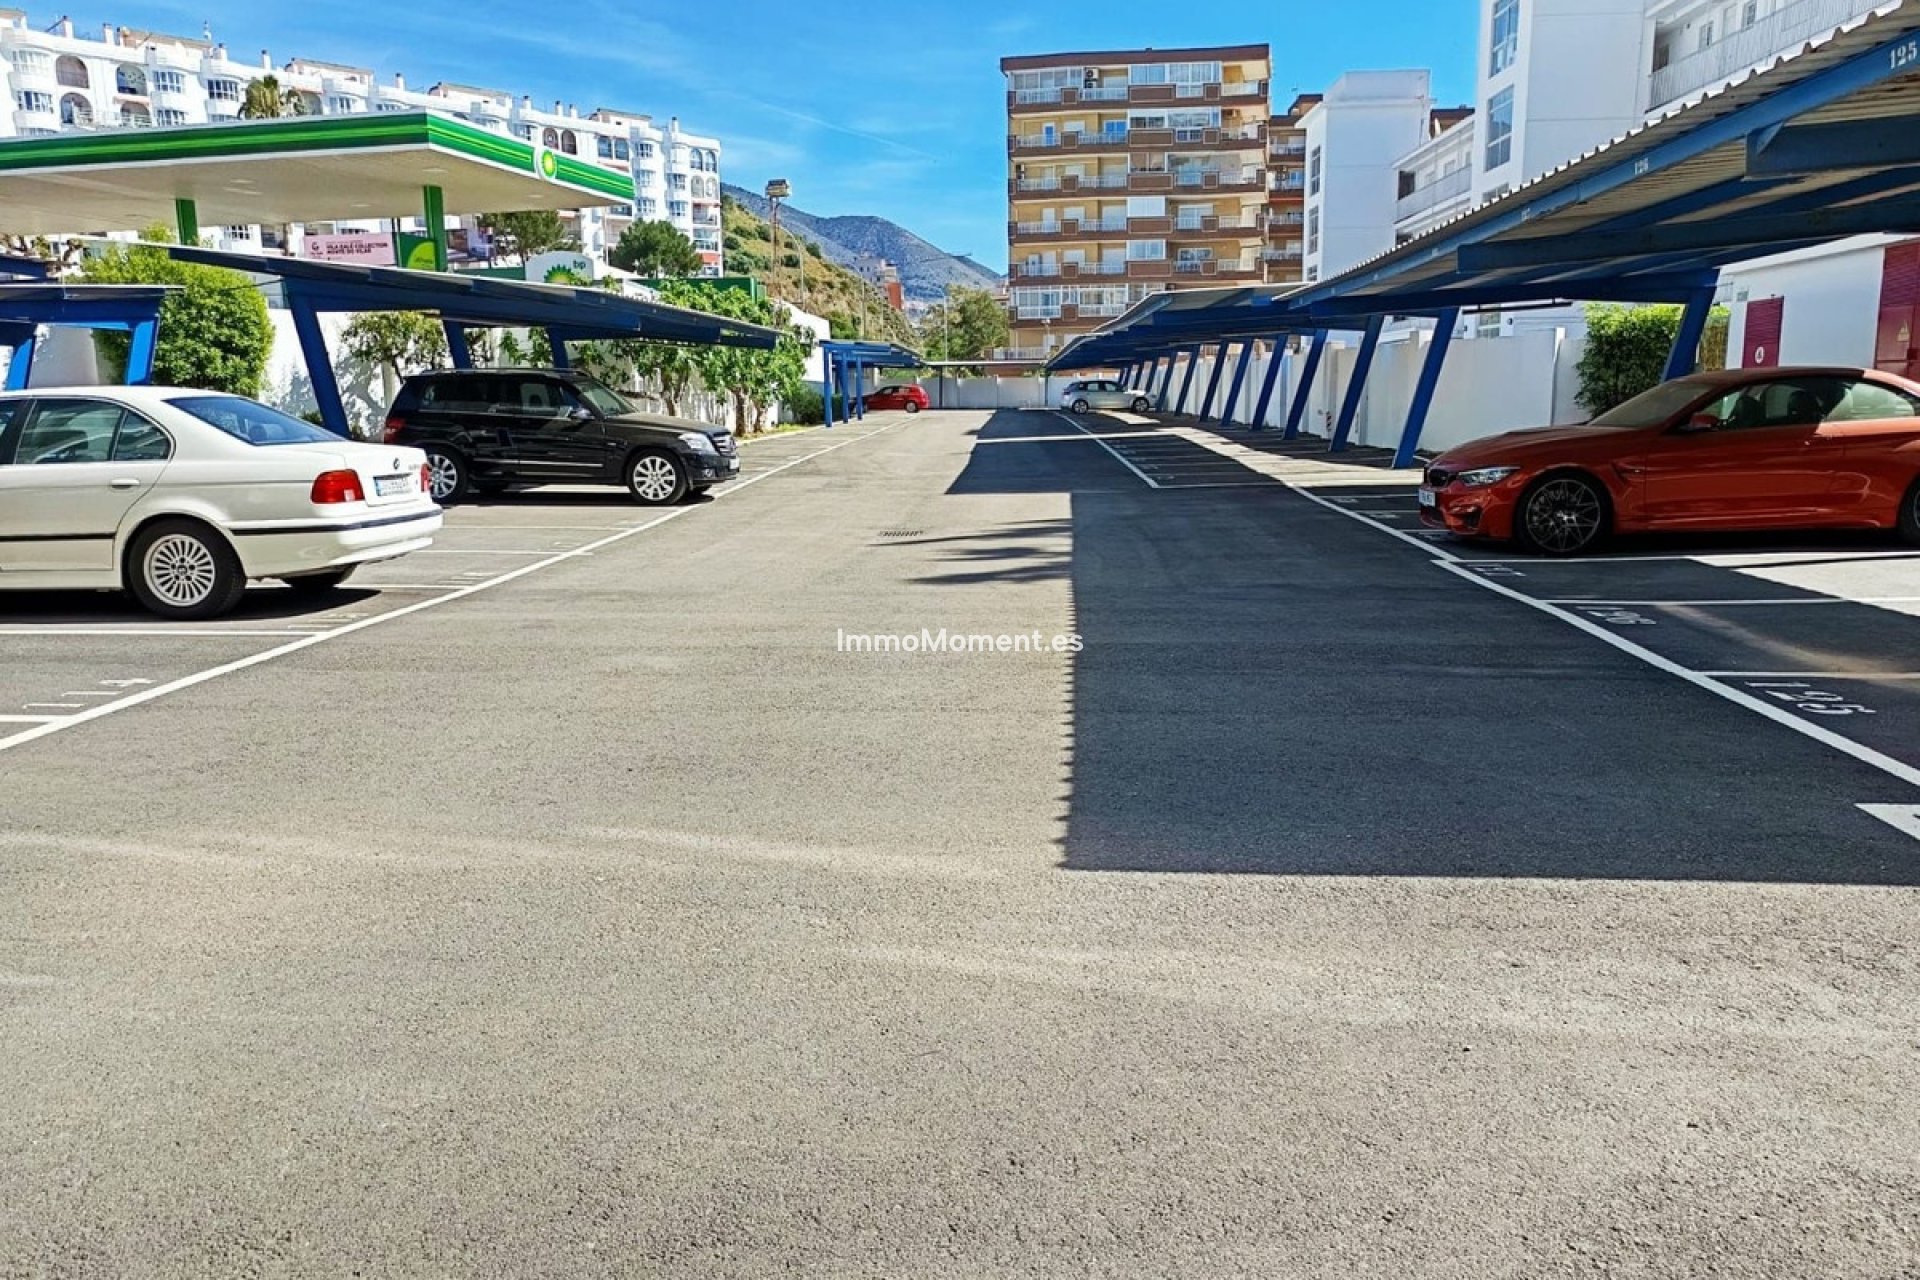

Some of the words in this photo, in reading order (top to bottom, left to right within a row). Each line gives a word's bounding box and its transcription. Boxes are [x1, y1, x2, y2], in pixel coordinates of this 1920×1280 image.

[1890, 40, 1918, 70] 125
[572, 259, 587, 270] bp
[1574, 605, 1657, 625] 126
[1743, 681, 1877, 715] 125
